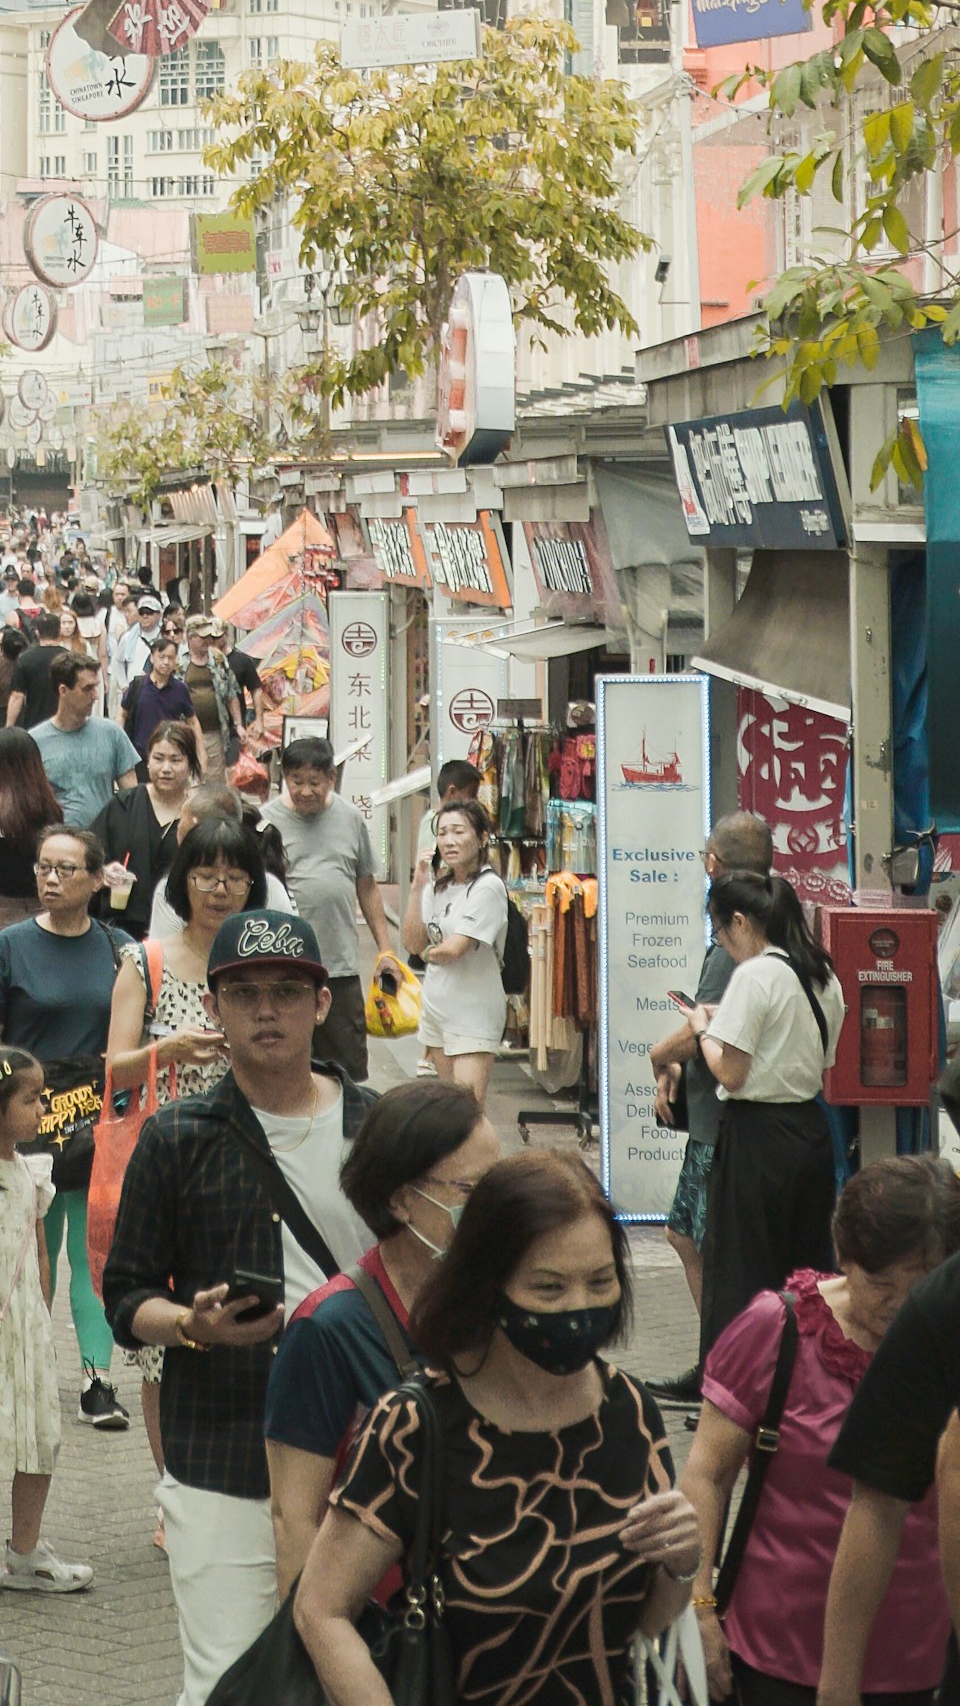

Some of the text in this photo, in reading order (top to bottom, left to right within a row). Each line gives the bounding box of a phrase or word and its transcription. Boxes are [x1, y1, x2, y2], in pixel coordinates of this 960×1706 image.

[70, 82, 103, 96] CHINATOWN
[72, 91, 104, 104] SINGAPORE
[64, 204, 87, 274] 牛车水
[612, 848, 695, 861] Exclusive
[630, 869, 668, 882] Sale
[625, 912, 689, 925] Premium
[632, 933, 682, 946] Frozen
[627, 954, 687, 968] Seafood
[876, 960, 894, 971] FIRE
[858, 971, 912, 982] EXTINGUISHER
[636, 997, 680, 1011] Meats
[618, 1040, 653, 1057] Vege
[625, 1082, 658, 1096] Asso
[627, 1104, 655, 1118] Deli
[641, 1125, 677, 1139] Food
[628, 1146, 685, 1161] Product
